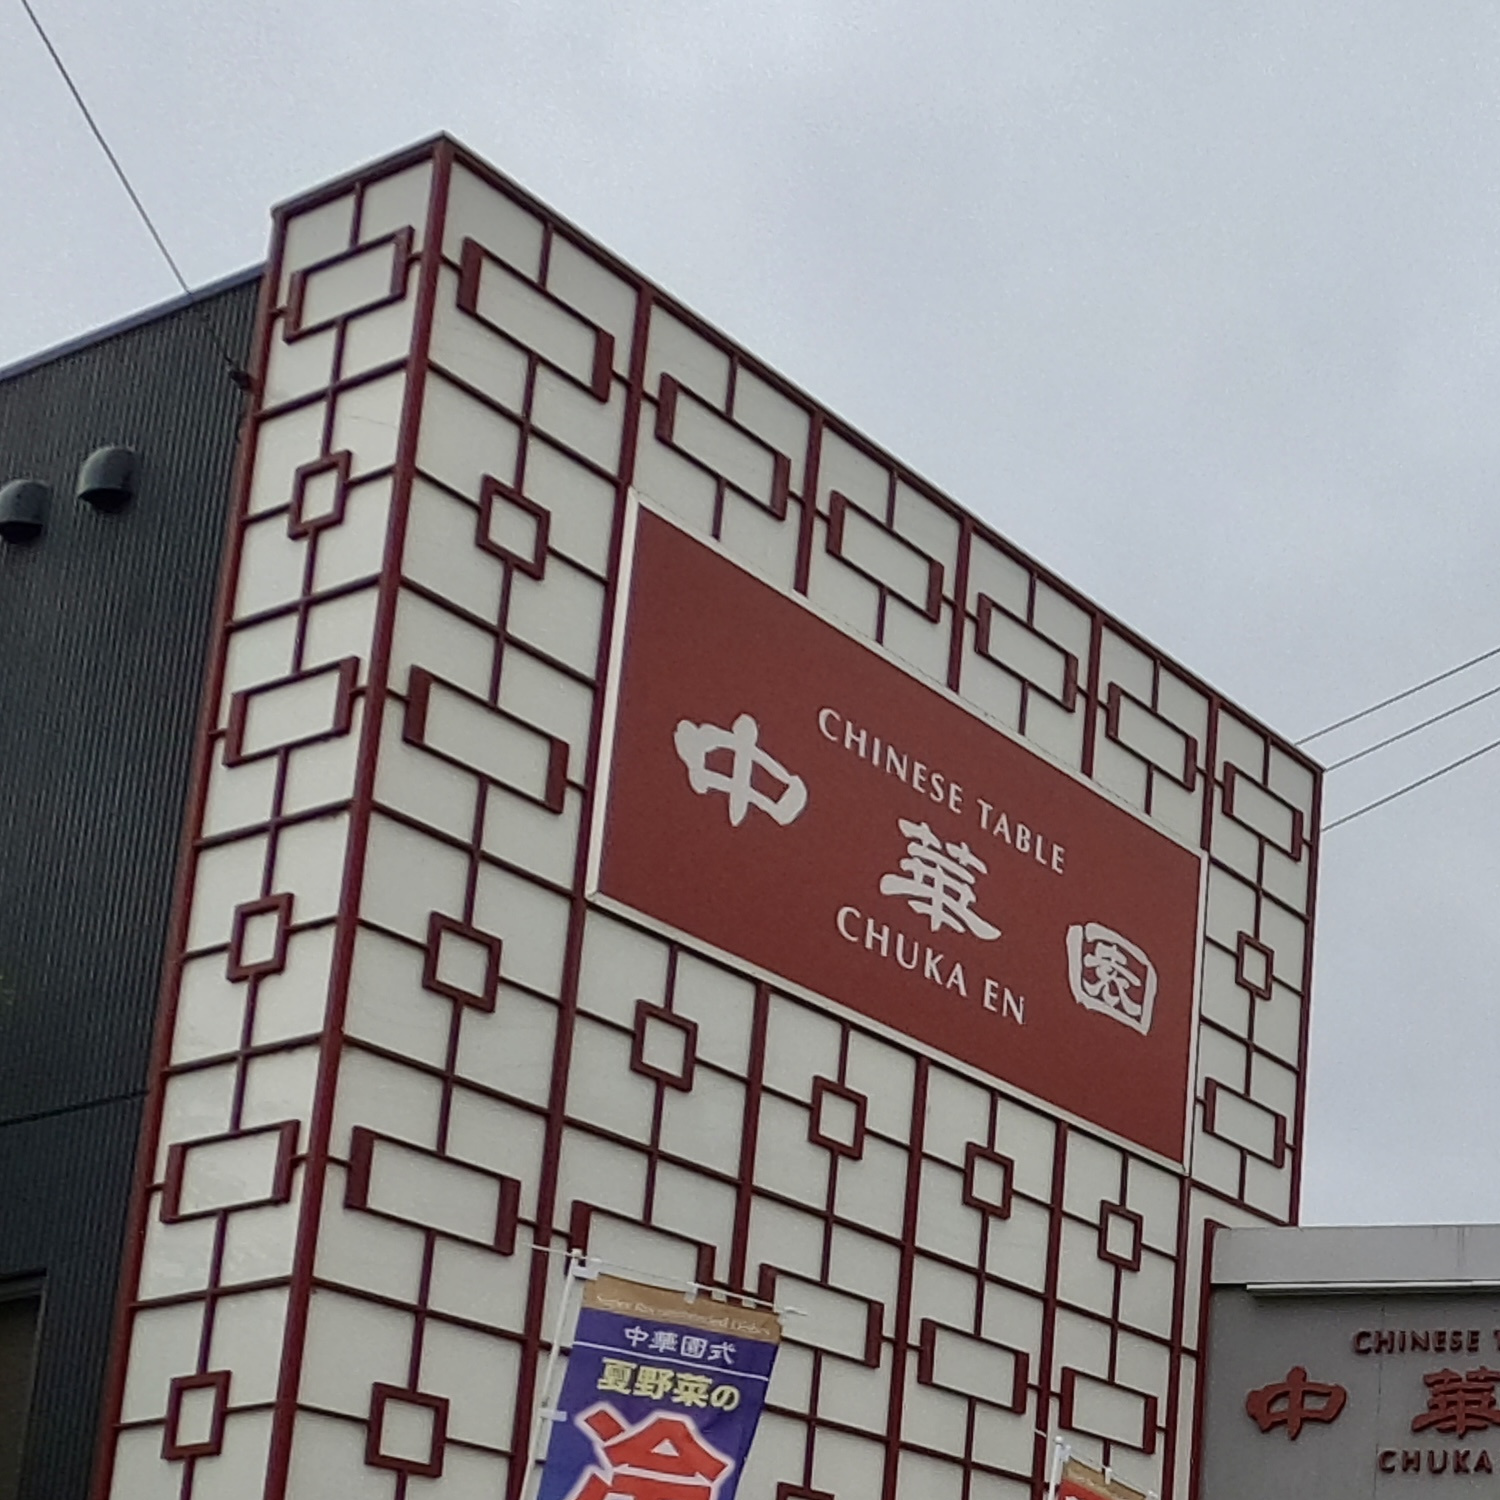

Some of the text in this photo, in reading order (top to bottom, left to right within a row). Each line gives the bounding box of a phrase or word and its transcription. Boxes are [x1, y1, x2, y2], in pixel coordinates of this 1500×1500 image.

[818, 708, 1065, 874] CHINESE TABLE
[836, 906, 1026, 1026] CHUKA EN
[1352, 1329, 1481, 1356] CHINESE
[596, 1357, 741, 1412] 夏野菜の
[1378, 1449, 1493, 1477] CHUKA
